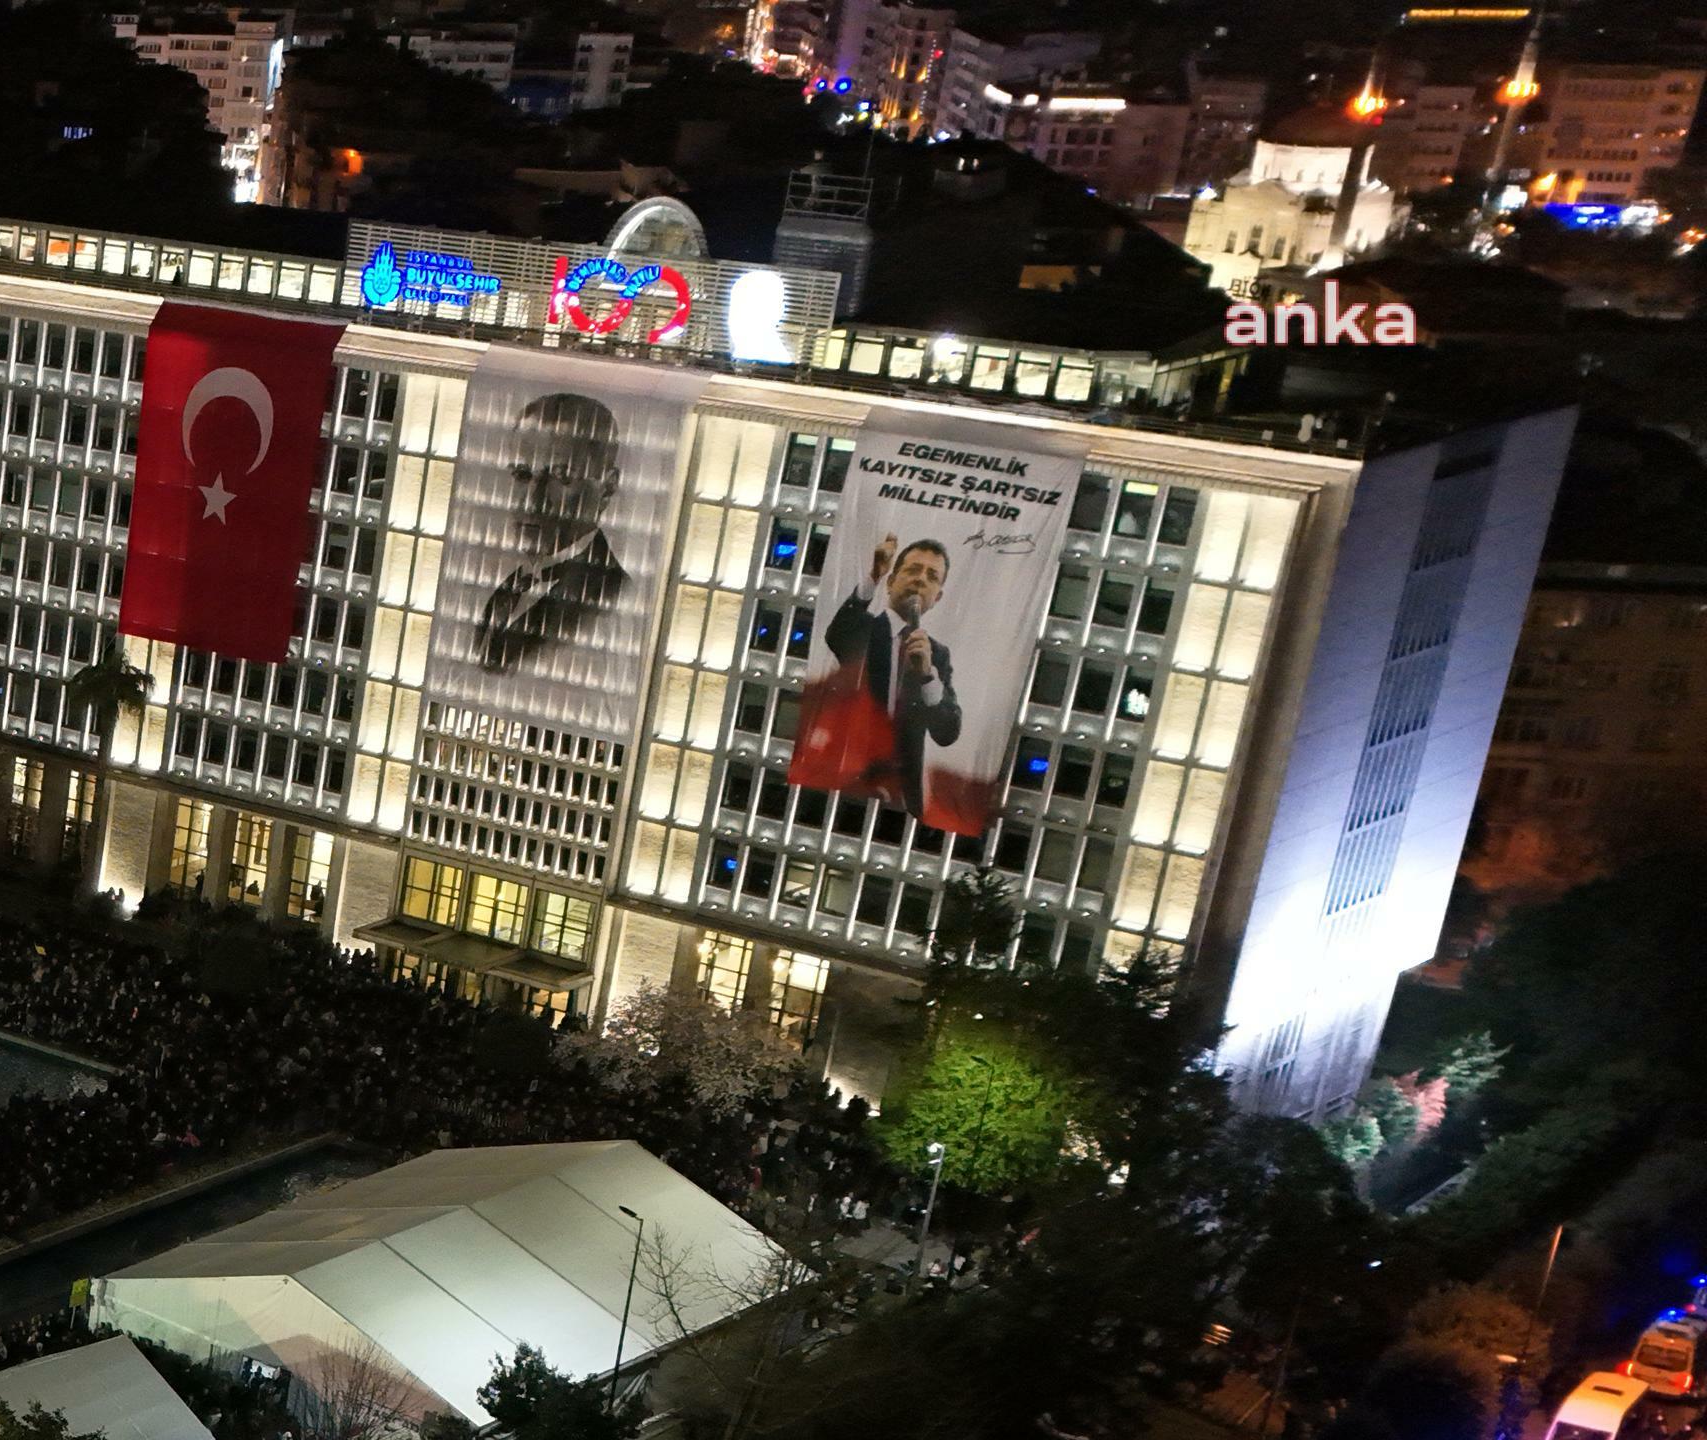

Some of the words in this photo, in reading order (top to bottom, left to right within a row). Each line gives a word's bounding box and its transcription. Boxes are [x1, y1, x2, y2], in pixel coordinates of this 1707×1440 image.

[897, 441, 1030, 477] EGEMENLİK
[859, 457, 957, 487] KAYITSIZ
[960, 474, 1062, 506] ŞARTSIZ
[878, 483, 1020, 522] MİLLETİNDİR
